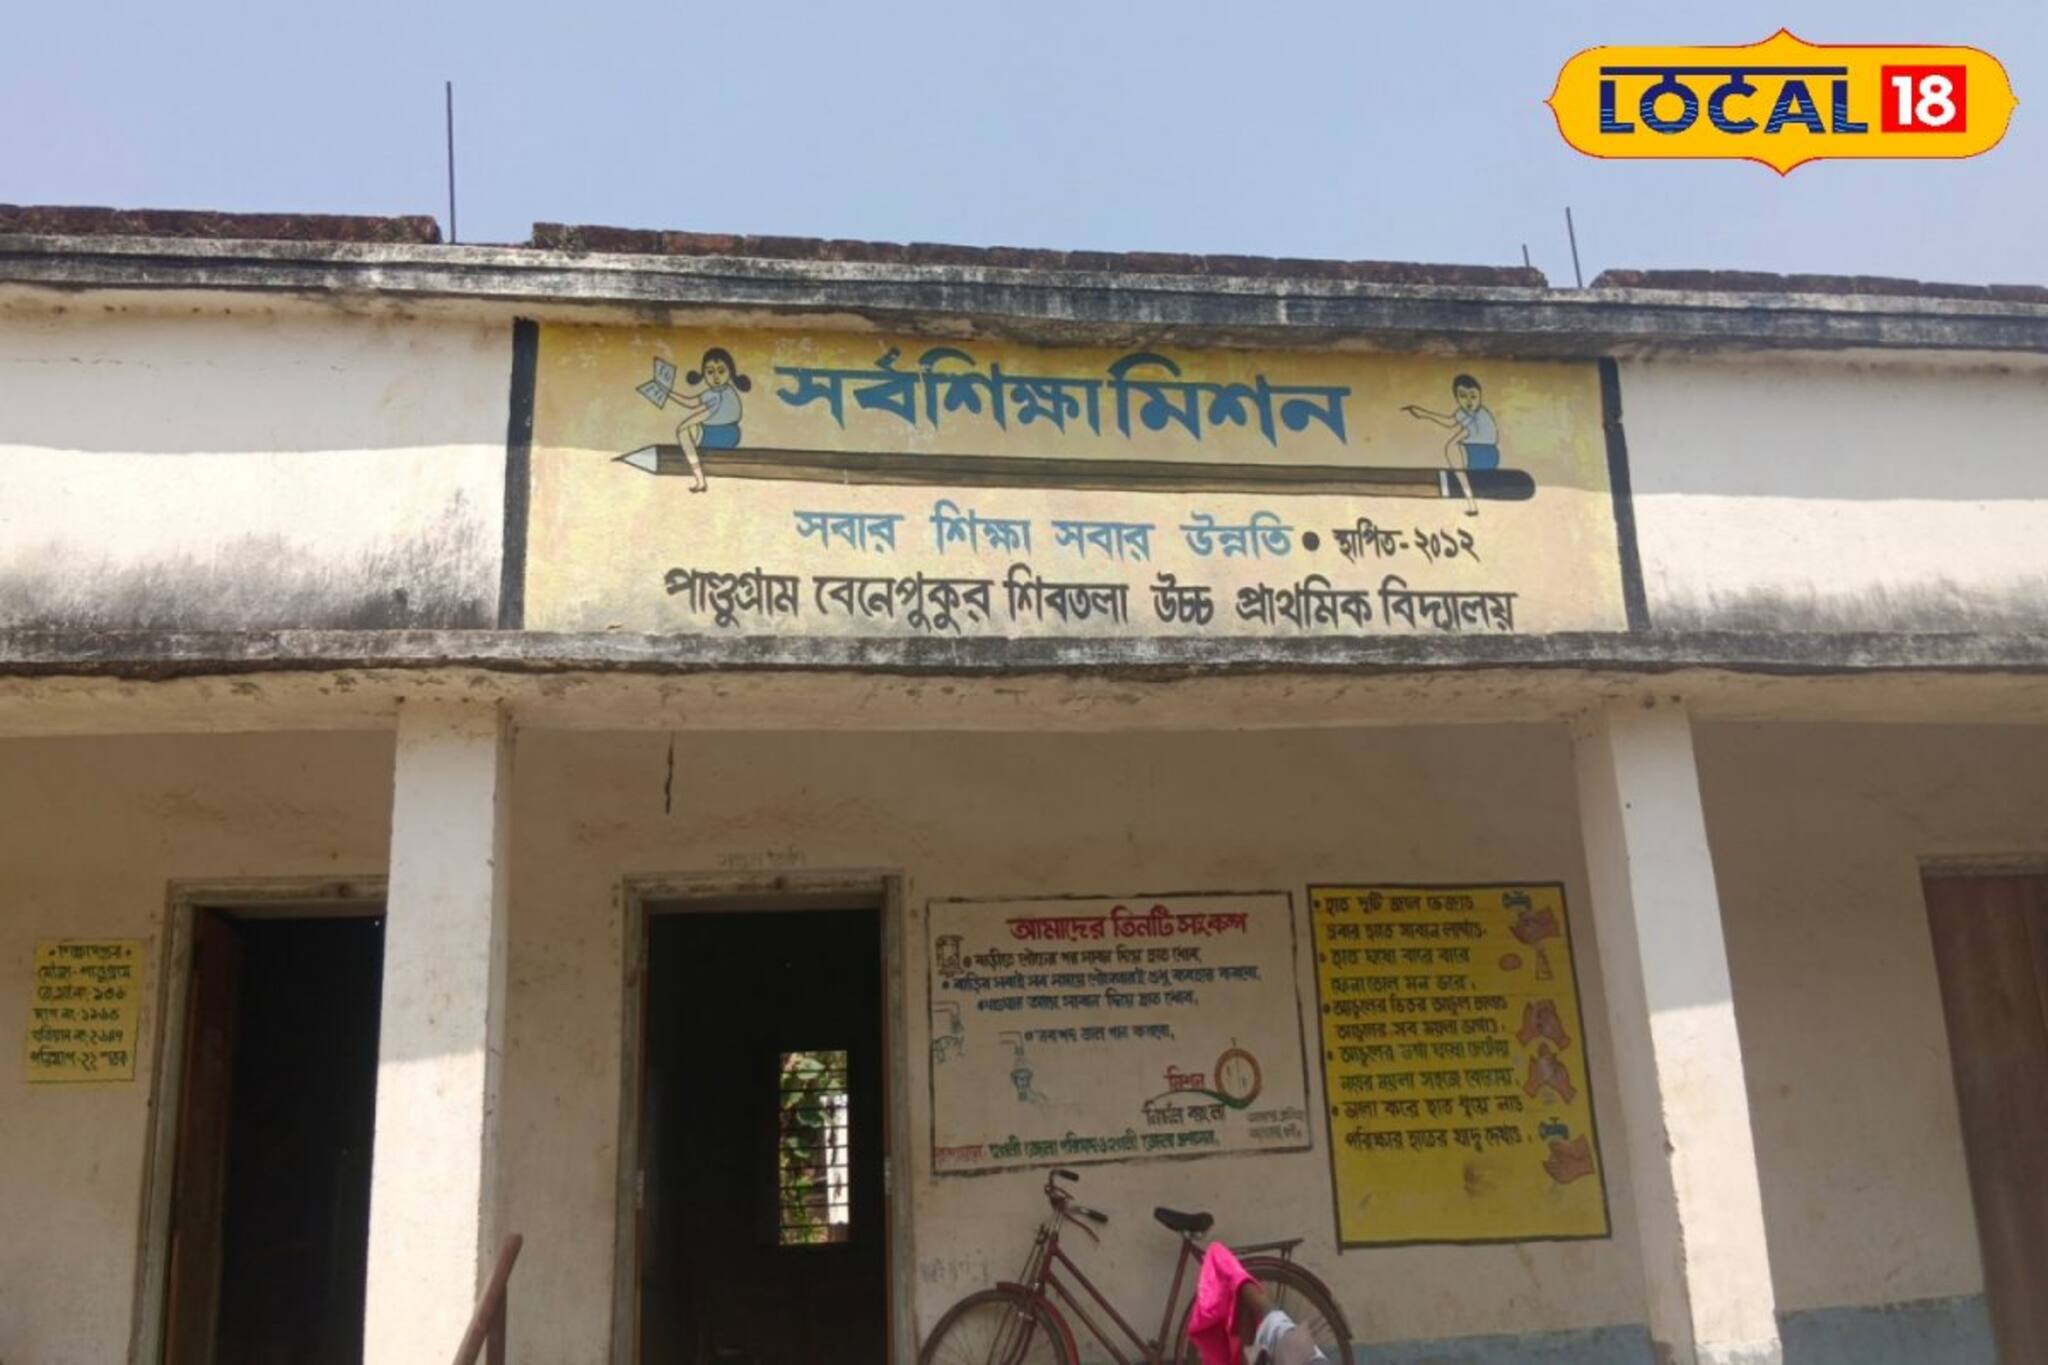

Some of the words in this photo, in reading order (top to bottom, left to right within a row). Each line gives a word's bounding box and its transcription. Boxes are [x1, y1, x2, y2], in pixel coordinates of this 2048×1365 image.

[794, 509, 903, 552] সবার
[930, 500, 1031, 554] শিক্ষা
[1052, 519, 1155, 562] সবার
[1181, 511, 1293, 560] উন্নতি
[812, 571, 995, 632] বেনেপুকুর
[1004, 563, 1128, 626] শিবতলা
[1150, 573, 1214, 625] উচ্চ
[1236, 574, 1368, 628] প্রাথমিক
[1378, 574, 1518, 631] বিদ্যালয়
[1006, 916, 1106, 941] আমাদের
[1110, 905, 1173, 938] তিনটি
